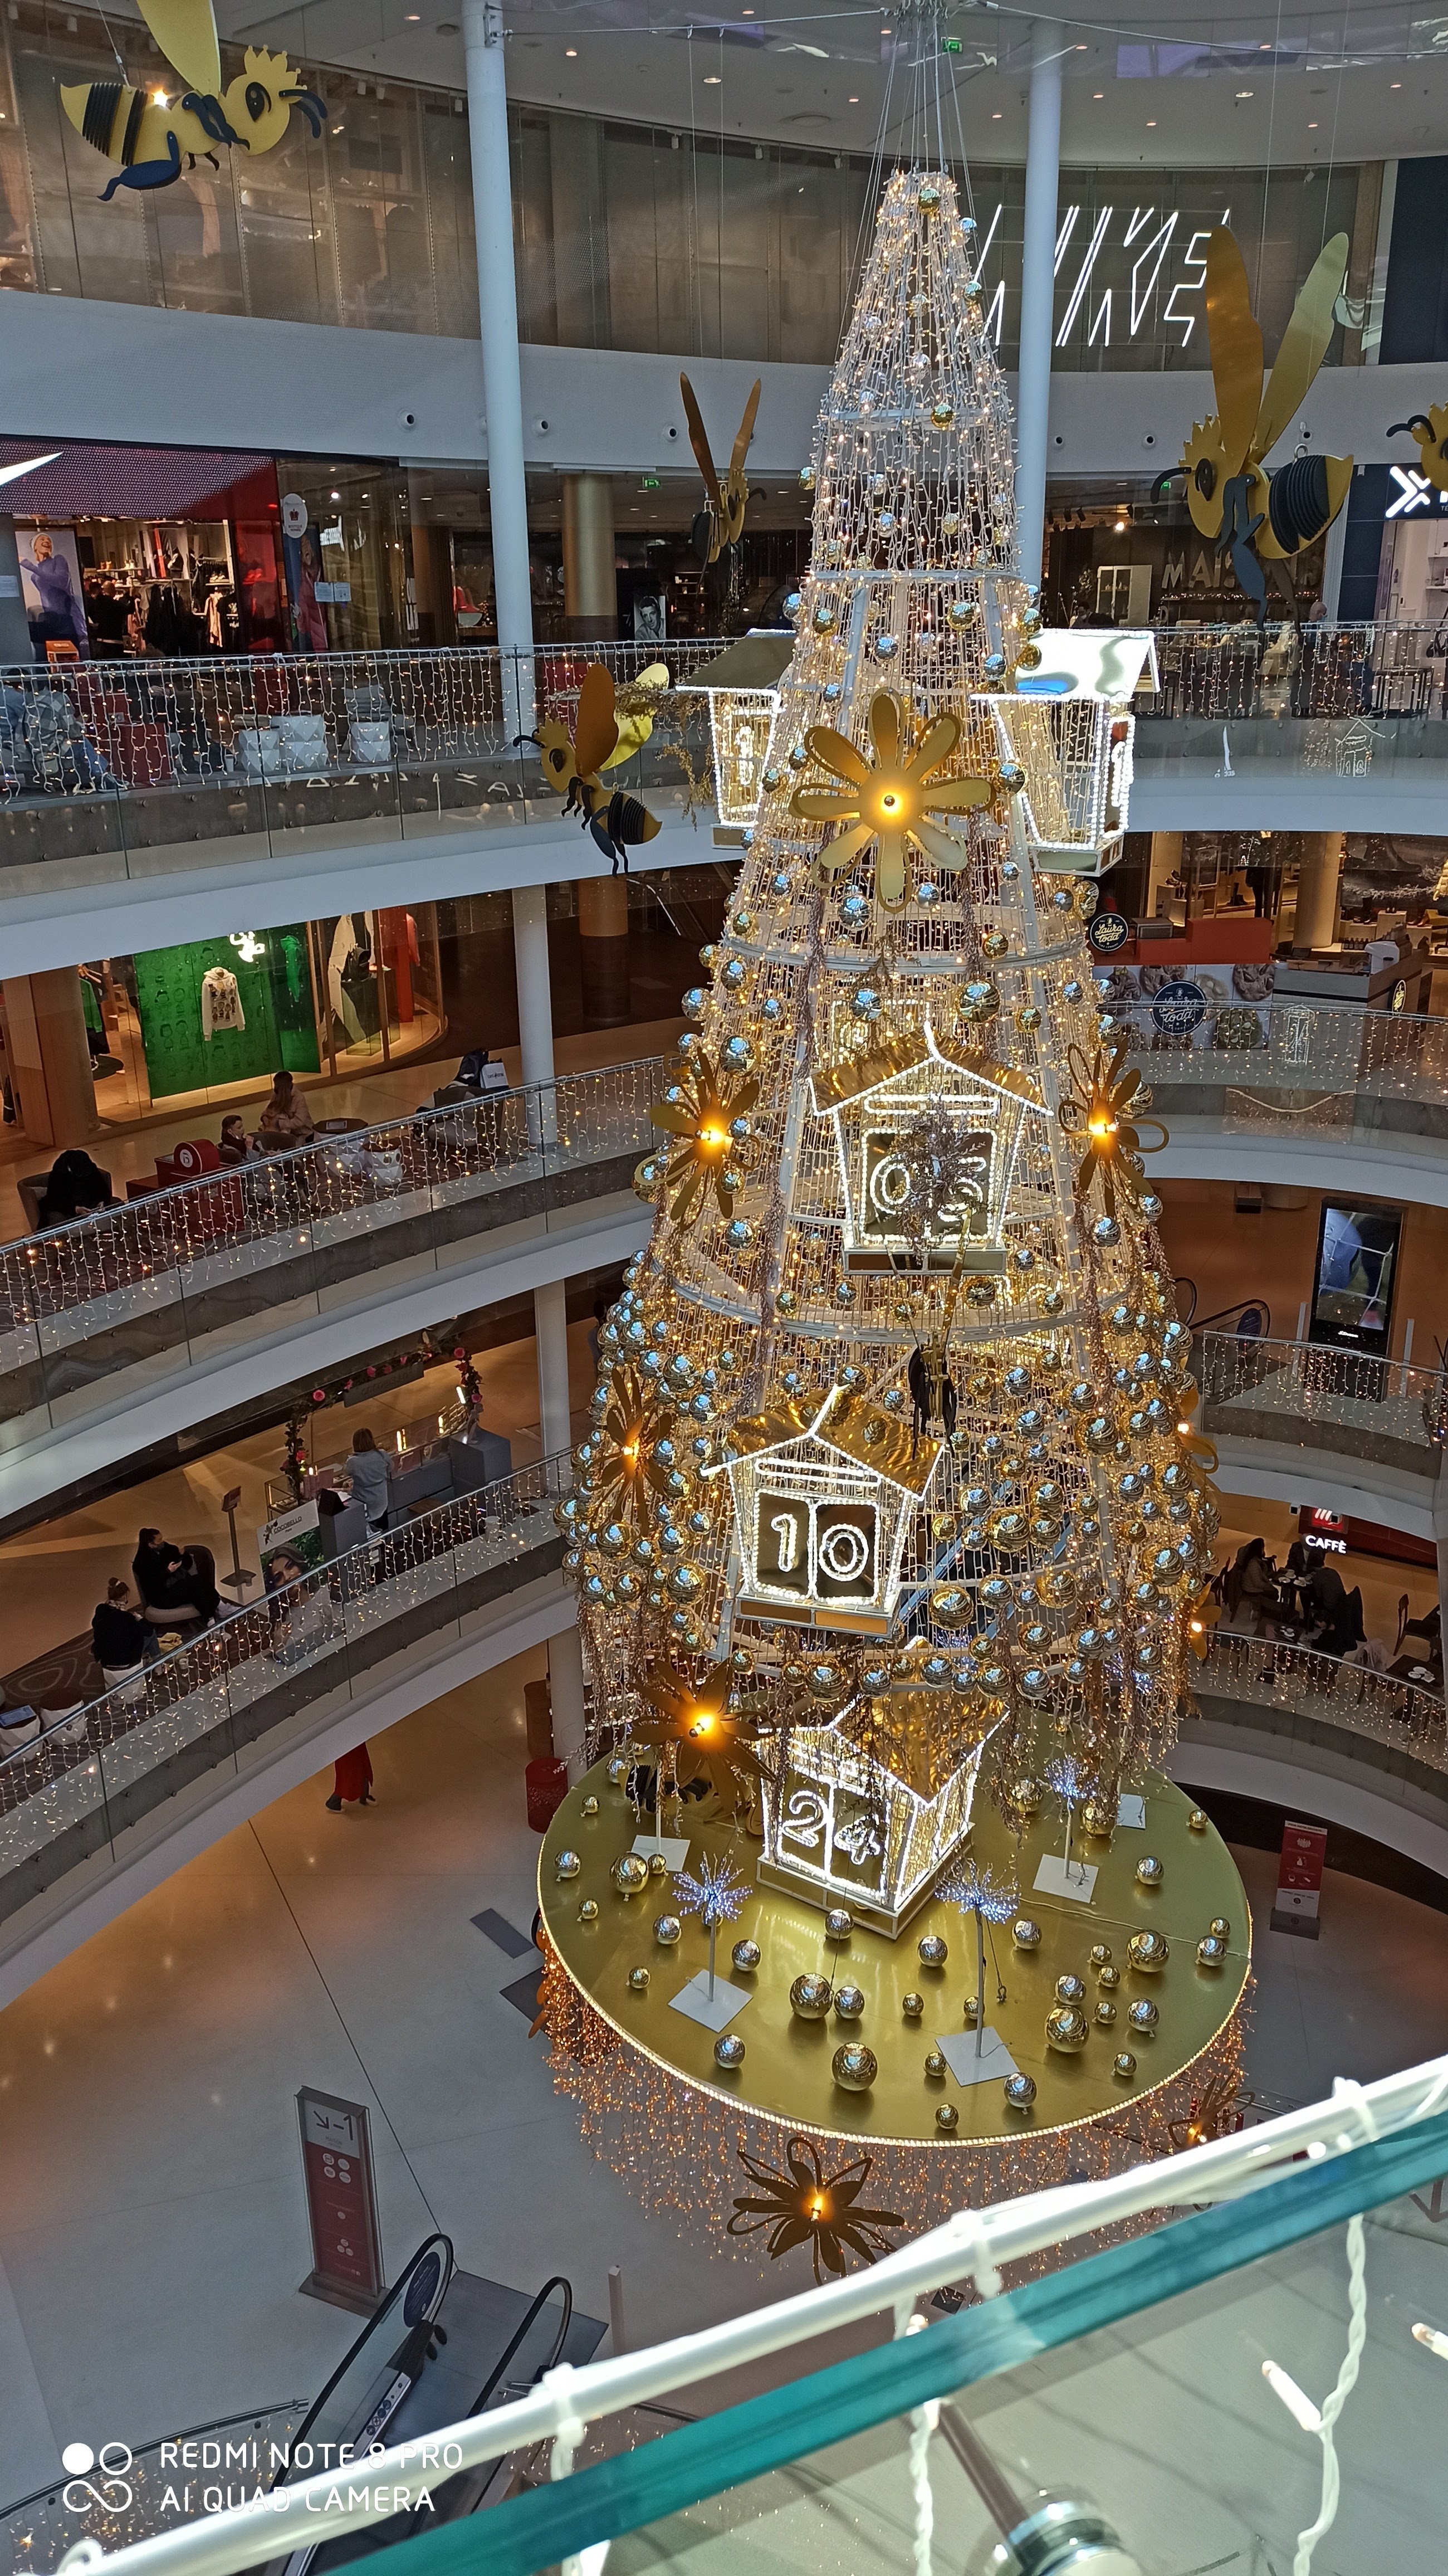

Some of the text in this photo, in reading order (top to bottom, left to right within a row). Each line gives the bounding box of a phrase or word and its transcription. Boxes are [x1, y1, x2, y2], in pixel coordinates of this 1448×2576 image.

[1095, 923, 1124, 935] Laura
[273, 1516, 302, 1534] COCOBELLO
[771, 1513, 869, 1582] 10
[1305, 1534, 1347, 1554] CAFFÈ
[782, 1790, 880, 1866] 24
